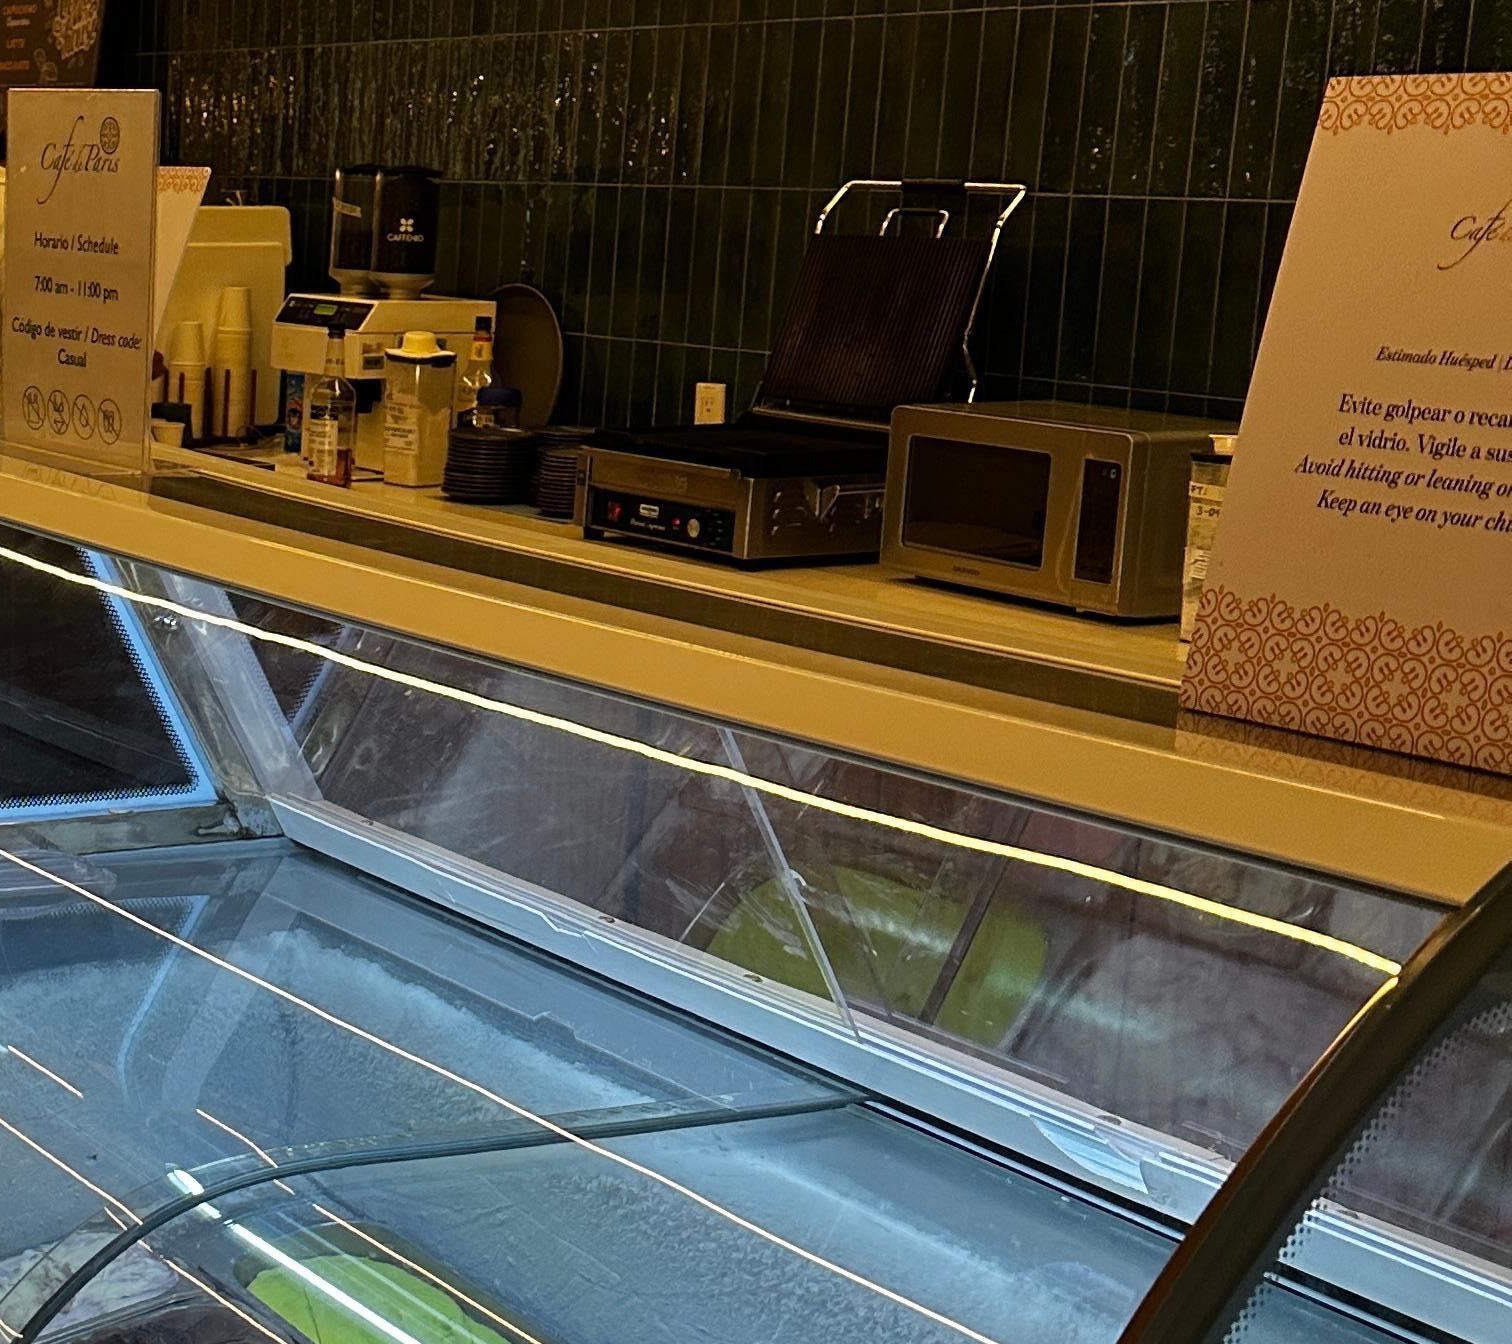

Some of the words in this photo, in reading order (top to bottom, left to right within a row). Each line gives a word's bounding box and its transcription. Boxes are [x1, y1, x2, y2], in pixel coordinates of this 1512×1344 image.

[33, 231, 69, 250] Horario
[76, 233, 119, 255] Schedule
[34, 275, 53, 293] 7:00
[54, 281, 68, 294] am
[103, 287, 118, 305] pm
[11, 316, 42, 340] Código
[43, 321, 56, 337] de
[58, 326, 82, 341] vestir
[90, 327, 116, 346] Dress
[57, 347, 87, 367] Casual
[1375, 345, 1437, 365] Estimado
[1438, 350, 1497, 371] Huésped
[1338, 393, 1382, 416] Evite
[1383, 399, 1451, 425] golpear
[1453, 409, 1465, 424] o
[1338, 426, 1355, 446] el
[1357, 429, 1410, 452] vidrio.
[1418, 433, 1467, 460] Vigile
[1469, 446, 1481, 460] a
[1294, 454, 1346, 477] Avoid
[1344, 459, 1404, 489] hitting
[1403, 472, 1426, 486] or
[1426, 468, 1495, 500] leaning
[1316, 489, 1357, 517] Keep
[1359, 501, 1382, 516] an
[1384, 504, 1414, 523] eye
[1415, 507, 1438, 523] on
[1437, 511, 1483, 529] your
